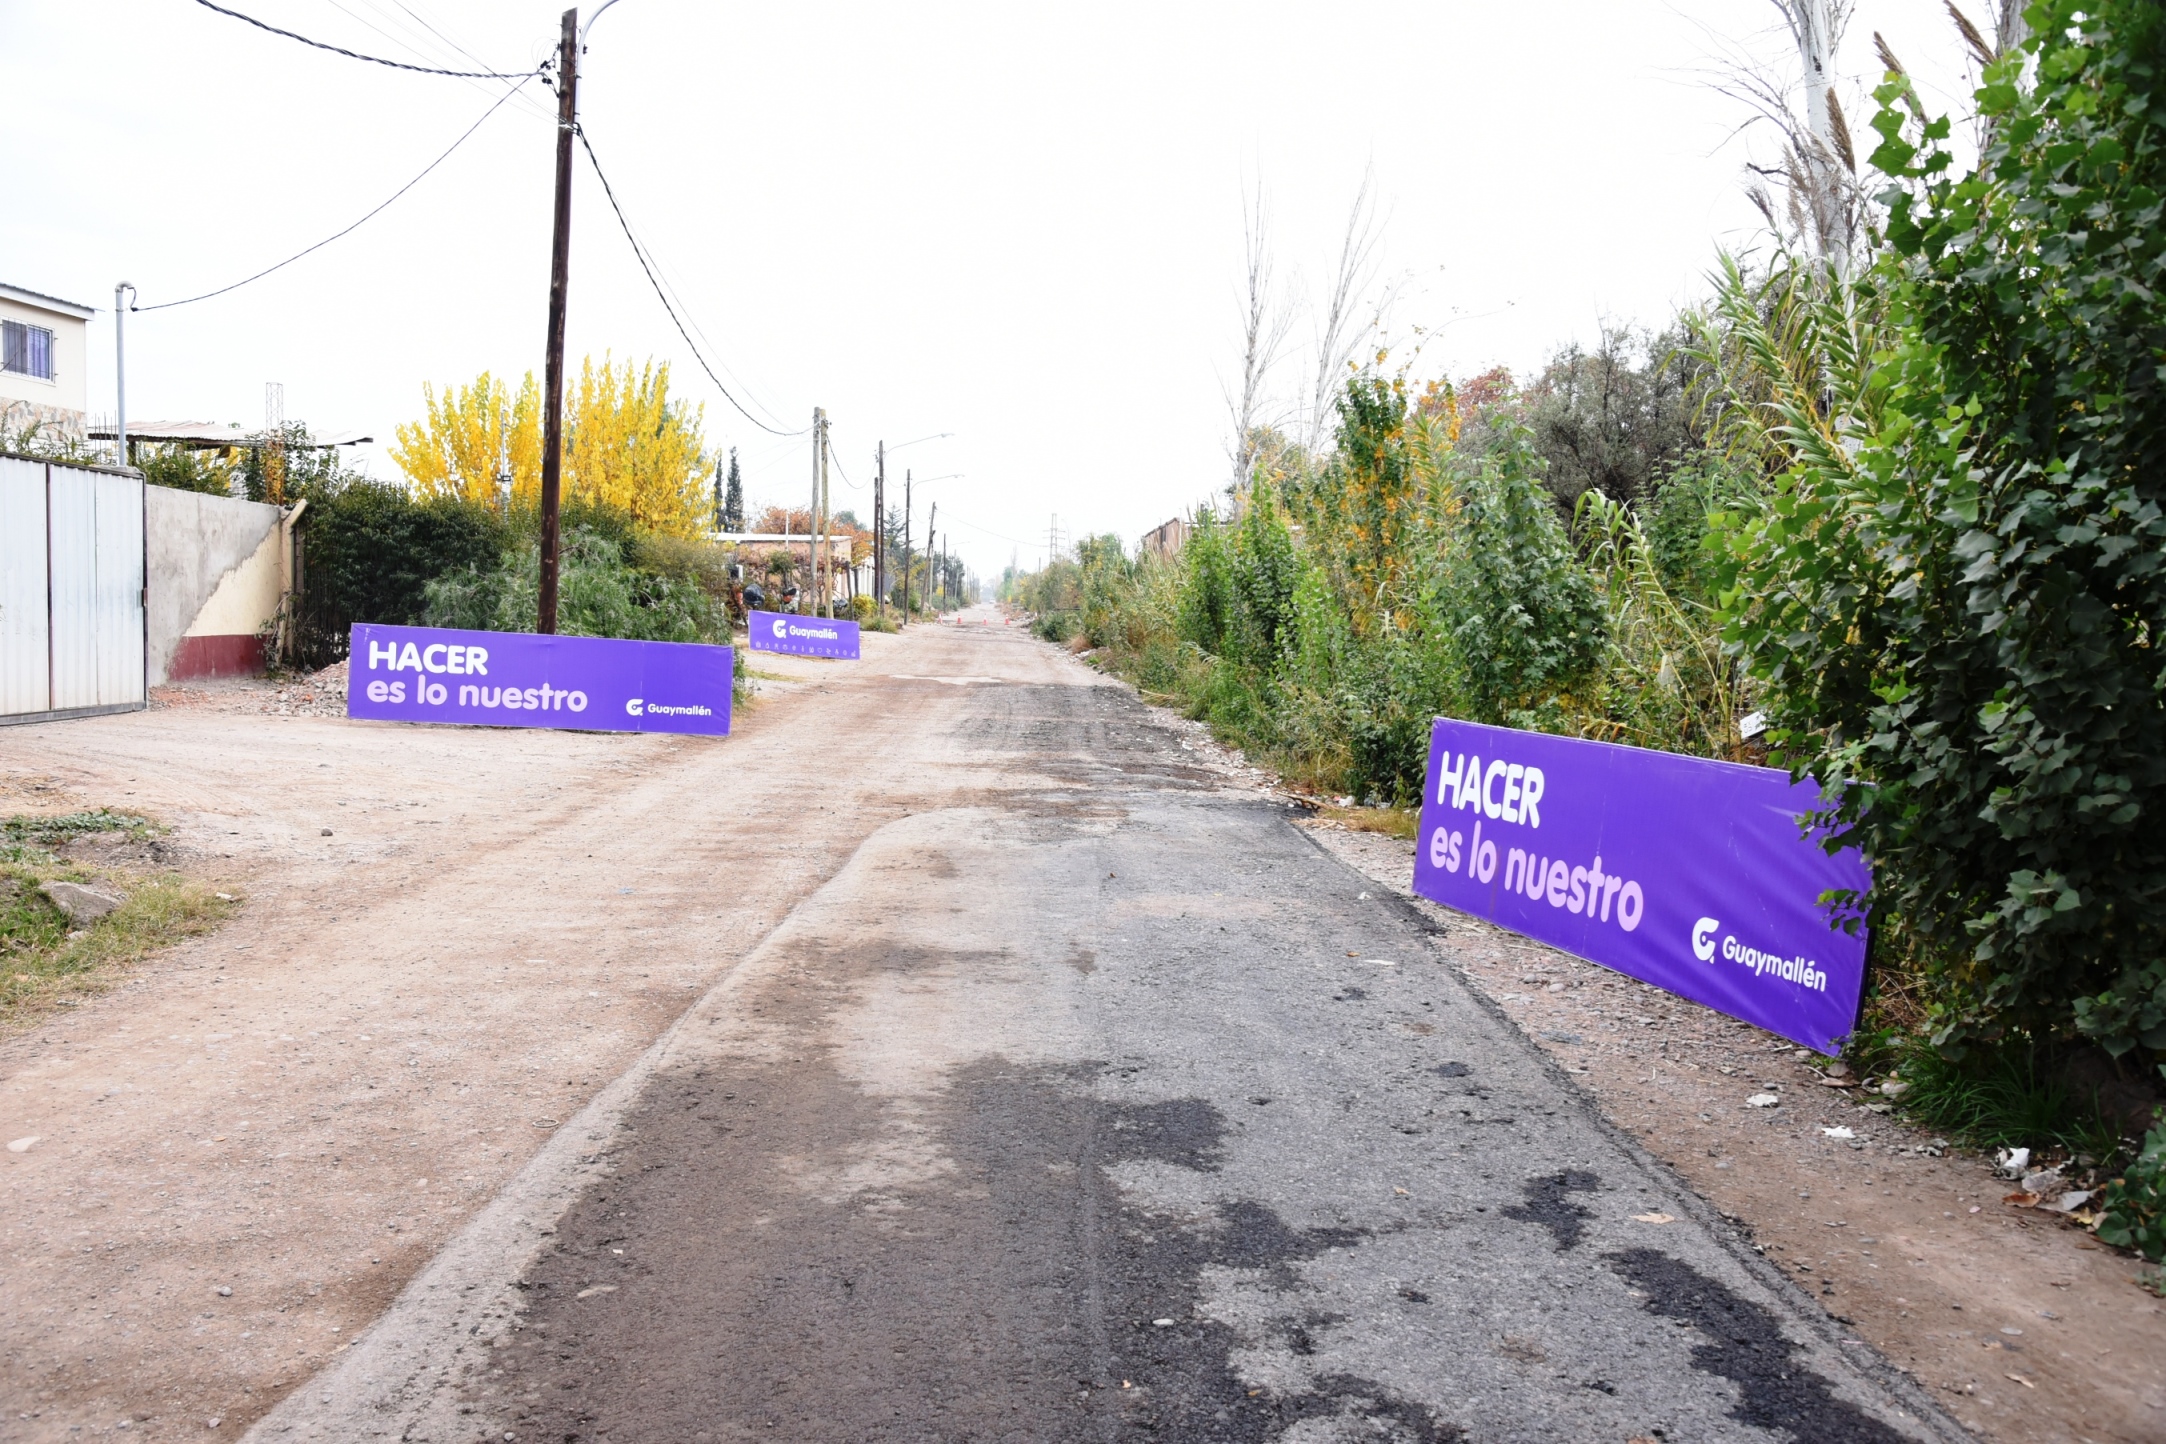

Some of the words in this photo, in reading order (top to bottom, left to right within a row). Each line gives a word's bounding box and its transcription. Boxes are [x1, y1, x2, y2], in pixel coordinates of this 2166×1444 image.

[789, 625, 838, 640] Guaymallén
[369, 641, 488, 675] HACER
[367, 680, 406, 704] es
[417, 674, 448, 706] lo
[459, 683, 588, 712] nuestro
[648, 704, 711, 717] Guaymallén
[1438, 751, 1545, 829] HACER
[1431, 827, 1463, 873] es
[1468, 820, 1497, 884] lo
[1504, 847, 1644, 932] nuestro
[1722, 935, 1827, 992] Guaymallén
